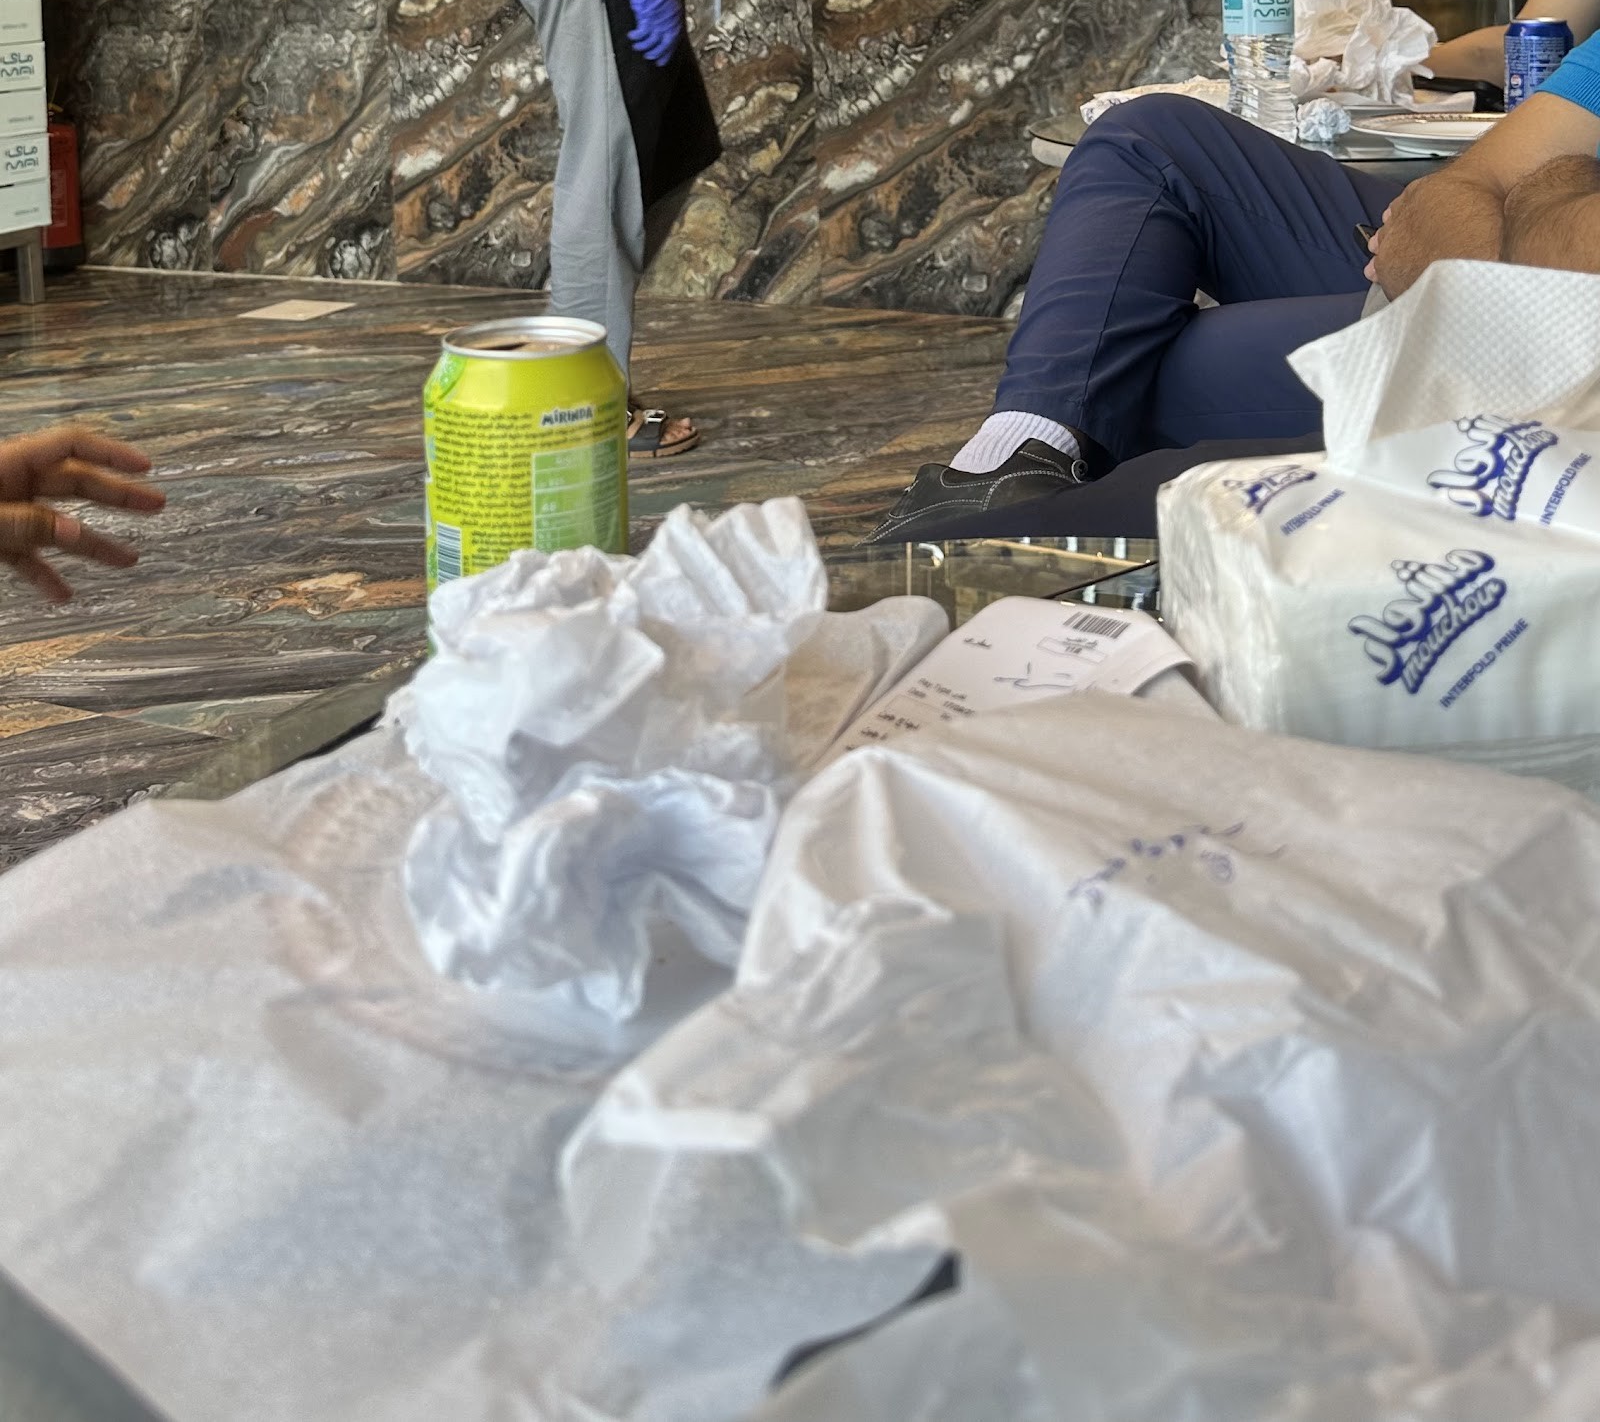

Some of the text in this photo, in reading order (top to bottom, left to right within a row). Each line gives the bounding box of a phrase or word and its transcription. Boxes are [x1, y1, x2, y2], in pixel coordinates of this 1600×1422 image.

[1539, 467, 1577, 525] INTERFOLD
[1399, 576, 1508, 695] mouchoir
[1439, 617, 1530, 708] INTERFOLD PRIME
